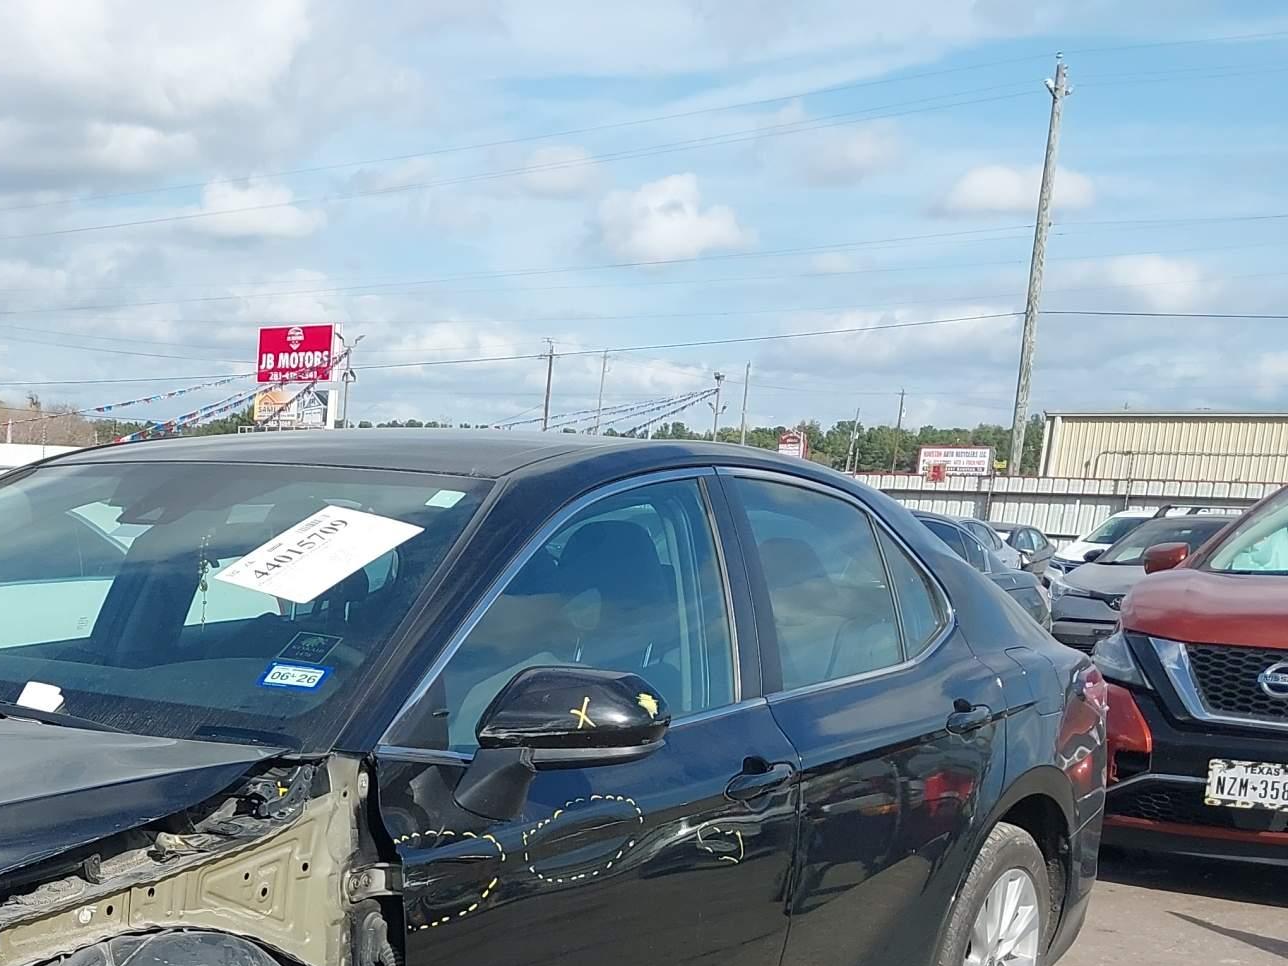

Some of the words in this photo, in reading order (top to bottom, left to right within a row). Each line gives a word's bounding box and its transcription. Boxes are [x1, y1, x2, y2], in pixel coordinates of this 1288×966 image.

[260, 353, 274, 370] JB
[277, 351, 329, 368] MOTORS
[254, 519, 348, 579] 44015709
[1244, 766, 1281, 776] TEXAS
